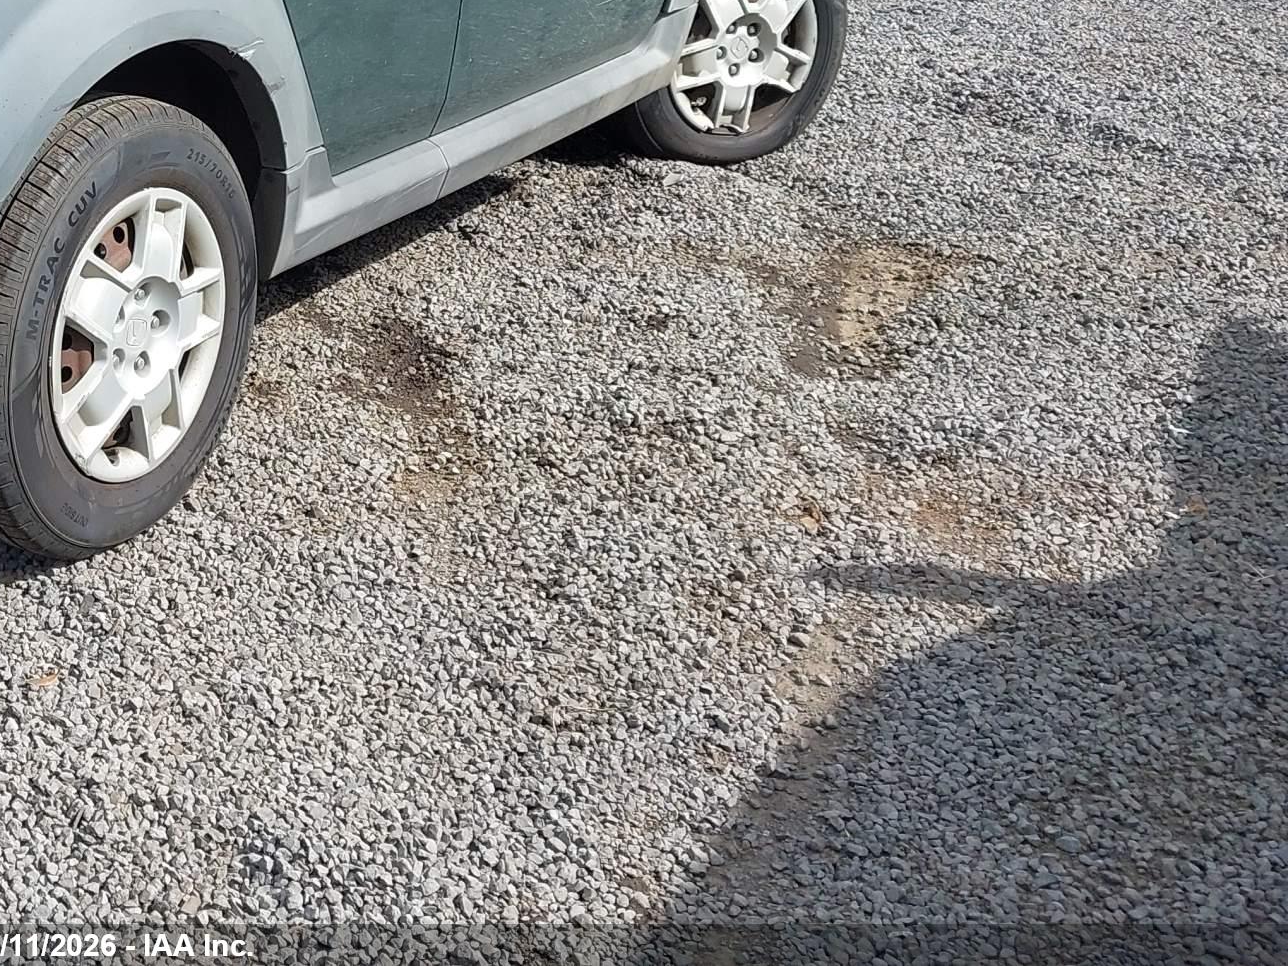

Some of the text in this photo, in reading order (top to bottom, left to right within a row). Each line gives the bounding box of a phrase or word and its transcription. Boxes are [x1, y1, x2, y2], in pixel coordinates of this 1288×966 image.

[186, 148, 236, 199] 215/70R16
[25, 181, 99, 341] M-TRAC CUV
